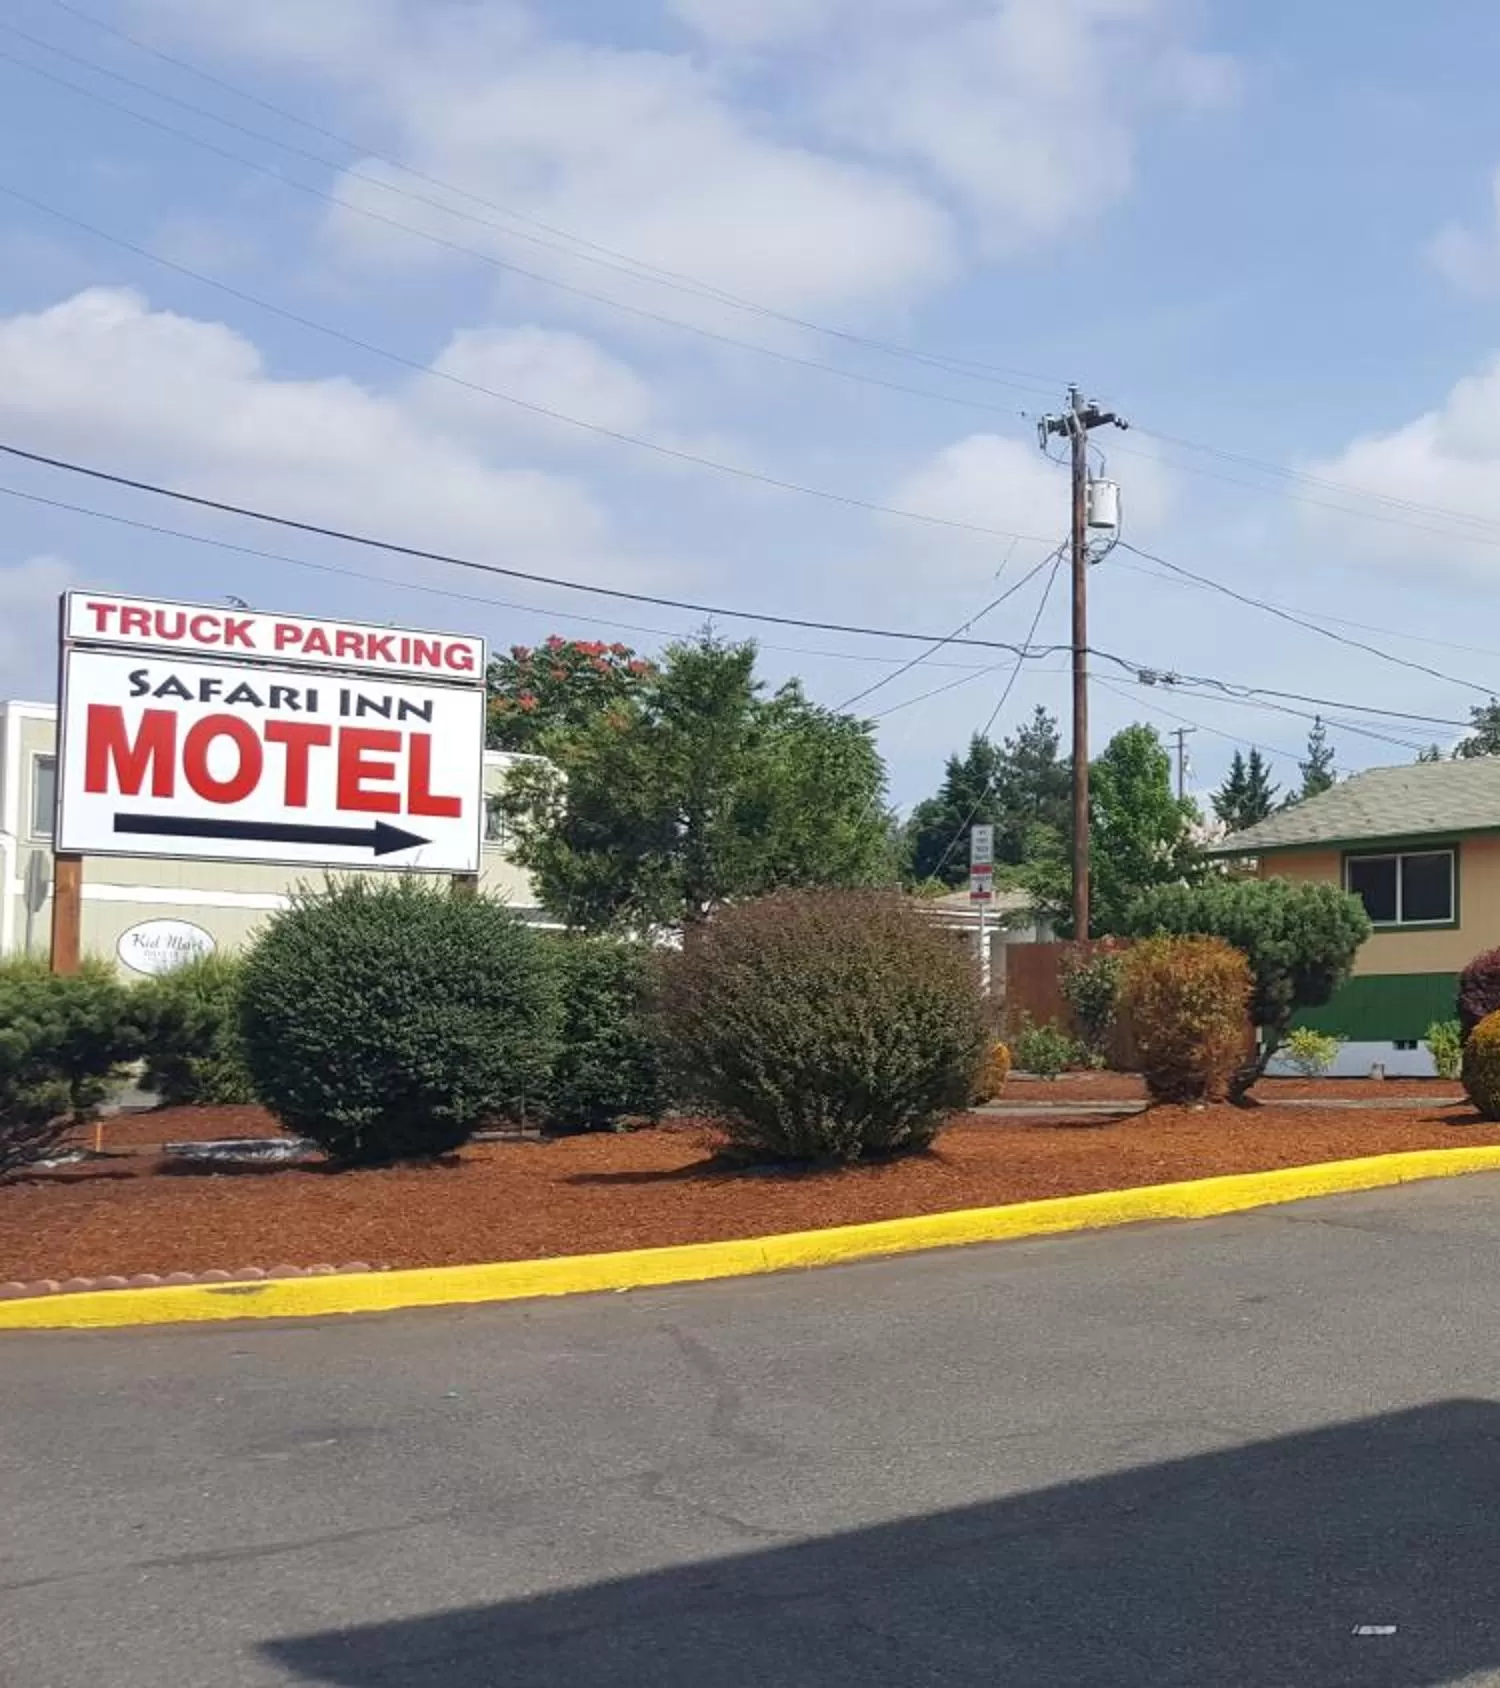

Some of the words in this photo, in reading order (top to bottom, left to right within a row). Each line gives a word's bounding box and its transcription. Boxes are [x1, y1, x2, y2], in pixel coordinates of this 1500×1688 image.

[86, 602, 256, 648] TRUCK
[274, 623, 474, 671] PARKING
[129, 669, 318, 713] SAFARI
[340, 689, 433, 723] INN
[84, 704, 462, 818] MOTEL
